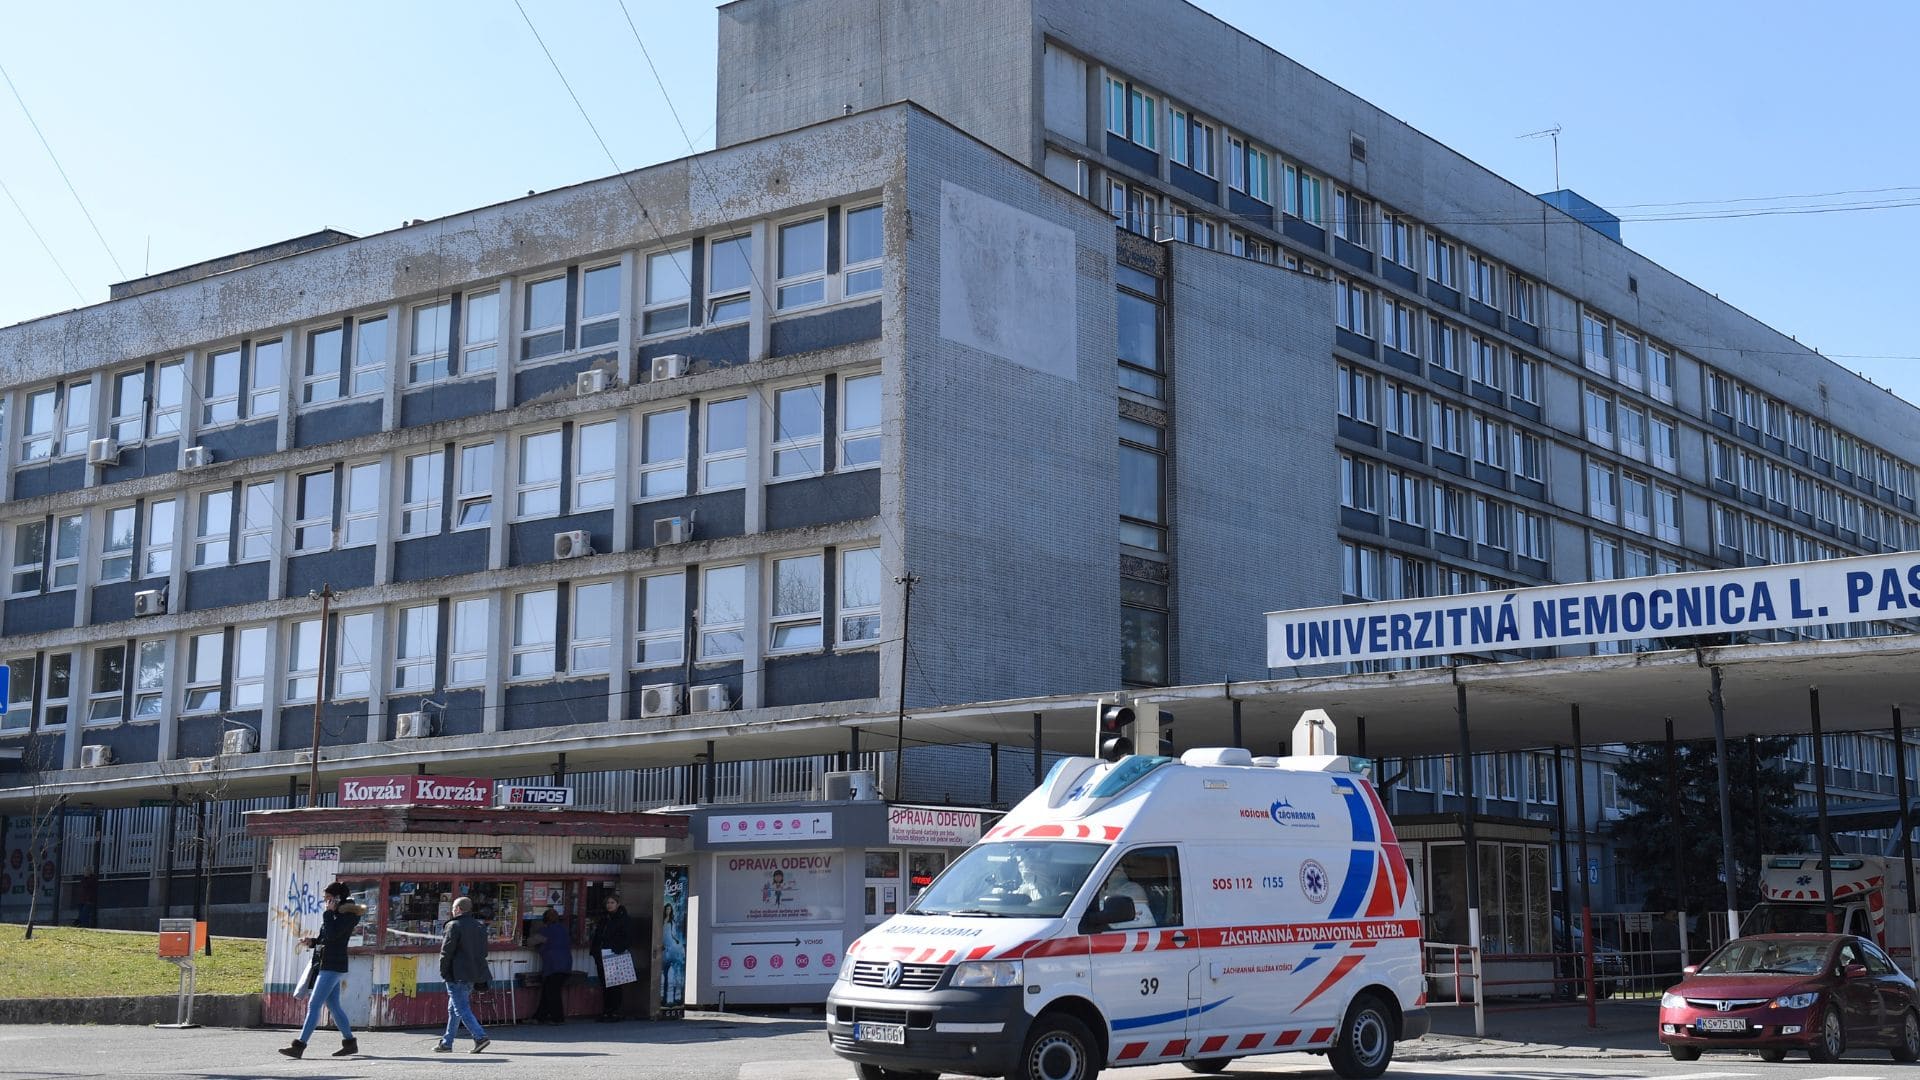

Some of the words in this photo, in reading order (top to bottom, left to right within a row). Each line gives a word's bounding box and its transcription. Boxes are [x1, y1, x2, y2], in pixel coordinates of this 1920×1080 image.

[1286, 594, 1520, 660] UNIVERZITNÁ
[1533, 581, 1777, 639] NEMOCNICA
[1790, 578, 1828, 619] L.
[343, 779, 405, 801] Korzár
[416, 779, 487, 802] Korzár
[526, 789, 565, 803] TIPOS
[892, 810, 934, 826] OPRAVA
[937, 812, 978, 828] ODEVOV
[397, 845, 455, 858] NOVINY
[577, 847, 626, 860] ČASOPISY
[729, 858, 778, 871] OPRAVA
[781, 856, 832, 870] ODEVOV
[1212, 878, 1232, 890] SOS
[1236, 878, 1253, 889] 112
[1220, 925, 1295, 946] ZÁCHRANNÁ
[1297, 922, 1363, 941] ZDRAVOTNÁ
[1366, 923, 1405, 938] SLUŽBA
[1140, 977, 1159, 996] 39
